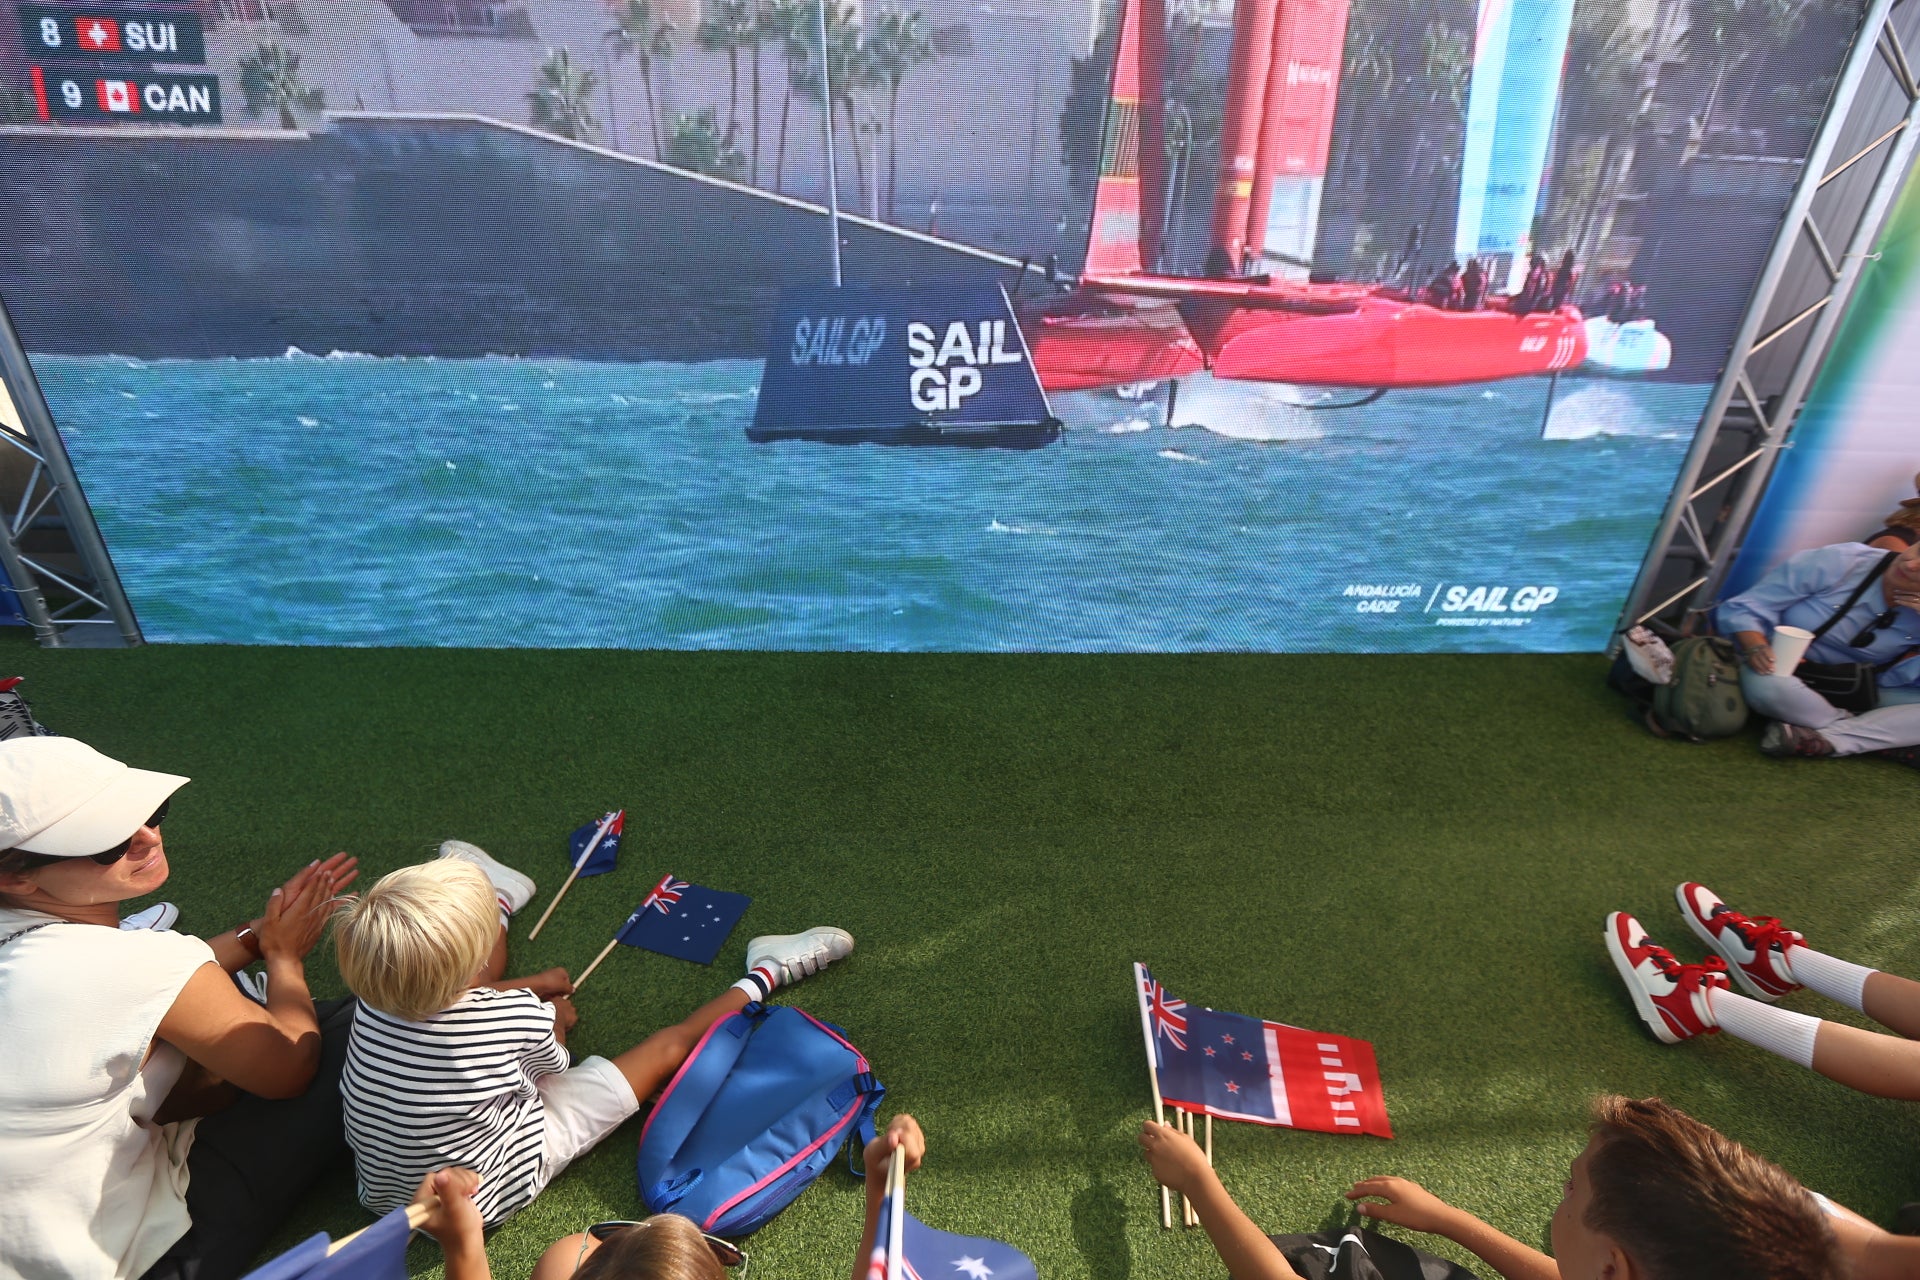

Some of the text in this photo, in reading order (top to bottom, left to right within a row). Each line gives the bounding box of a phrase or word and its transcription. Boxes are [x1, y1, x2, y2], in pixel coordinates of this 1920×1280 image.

[39, 16, 178, 52] 8 SUI
[61, 79, 211, 112] 9 CAN
[907, 320, 1023, 368] SAIL
[909, 367, 984, 411] GP
